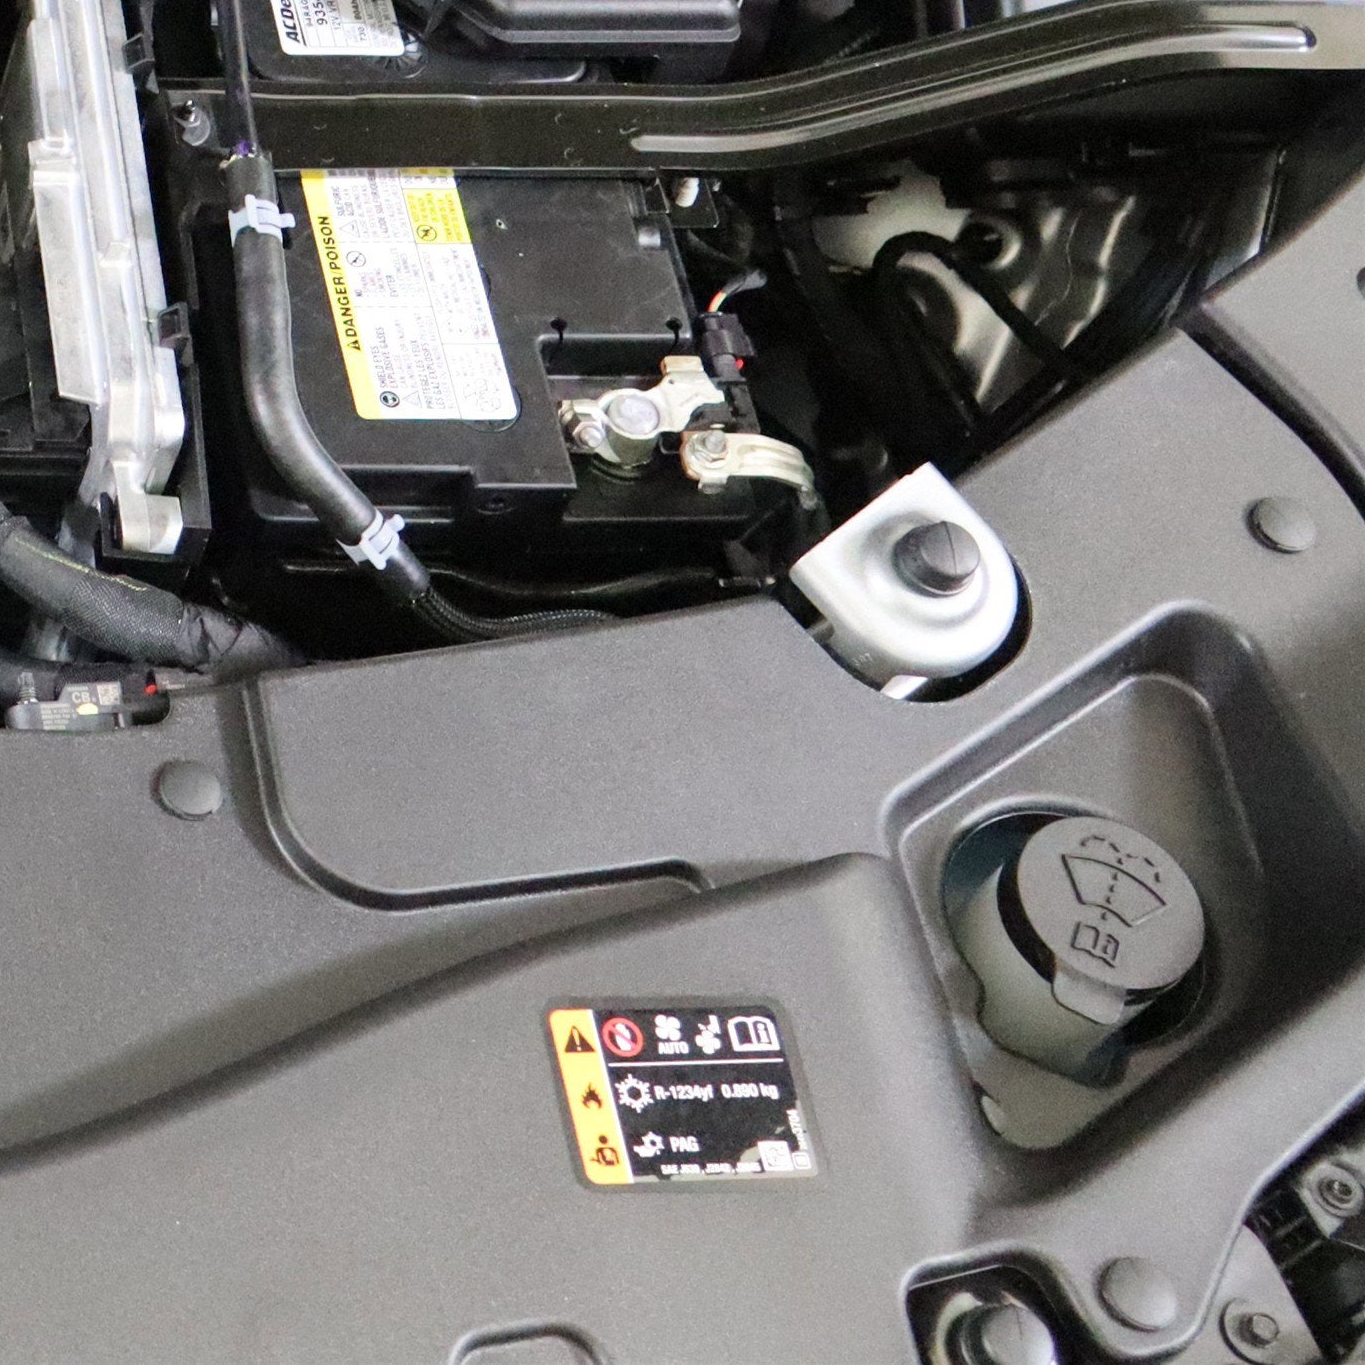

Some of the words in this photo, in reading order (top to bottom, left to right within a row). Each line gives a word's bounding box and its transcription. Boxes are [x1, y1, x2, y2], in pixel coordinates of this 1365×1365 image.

[332, 186, 345, 217] SULFURIC
[317, 214, 357, 338] DANGER/POISON
[375, 327, 388, 349] GASES
[370, 345, 382, 363] EYES
[372, 364, 388, 389] SHIELD
[381, 351, 398, 389] EXPLOSIVE
[434, 397, 446, 409] LES
[71, 691, 91, 703] CB
[658, 1041, 690, 1055] AUTO
[654, 1084, 714, 1103] R-1234yf
[761, 1082, 780, 1101] kg
[670, 1137, 700, 1153] PAG
